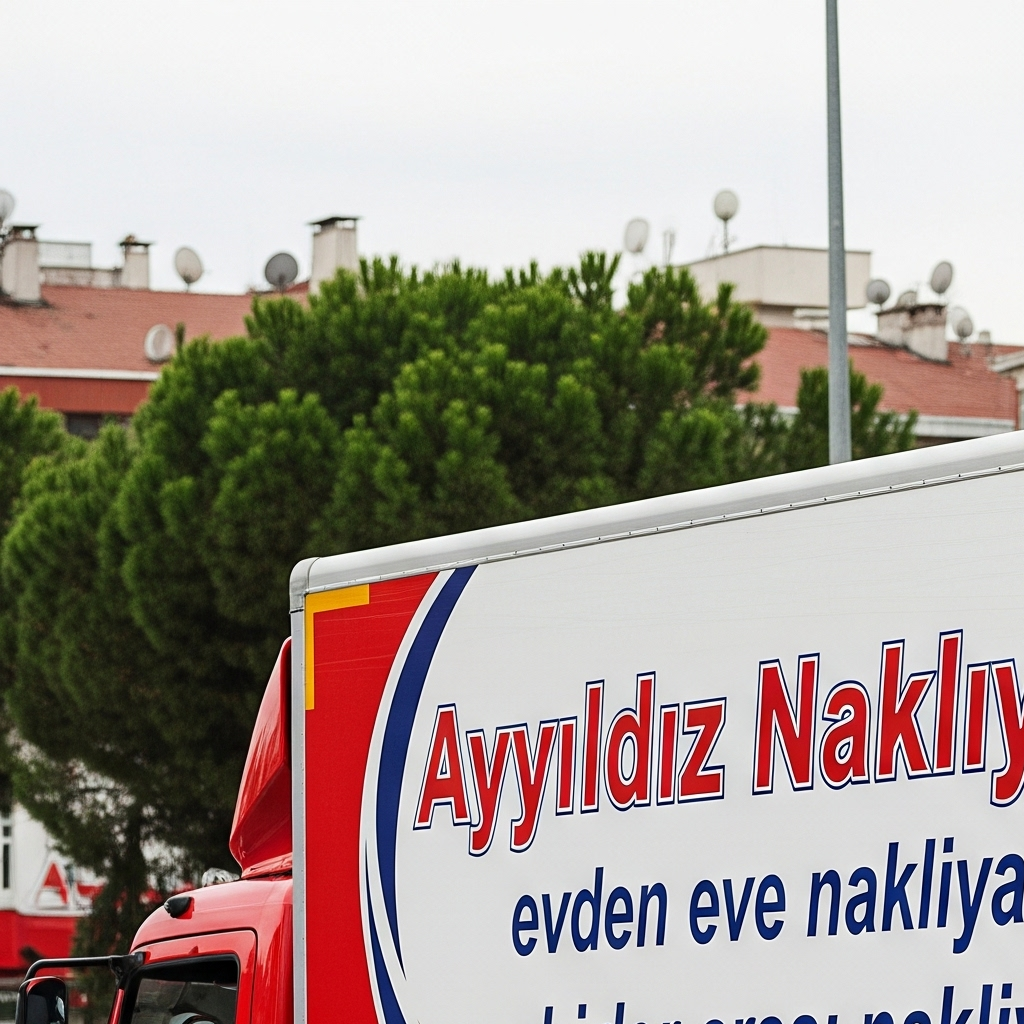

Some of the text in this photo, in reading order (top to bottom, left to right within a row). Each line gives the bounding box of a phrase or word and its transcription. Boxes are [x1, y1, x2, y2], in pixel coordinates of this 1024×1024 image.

[413, 671, 727, 857] Ayyıldız
[511, 867, 668, 956] evden
[688, 871, 786, 944] eve
